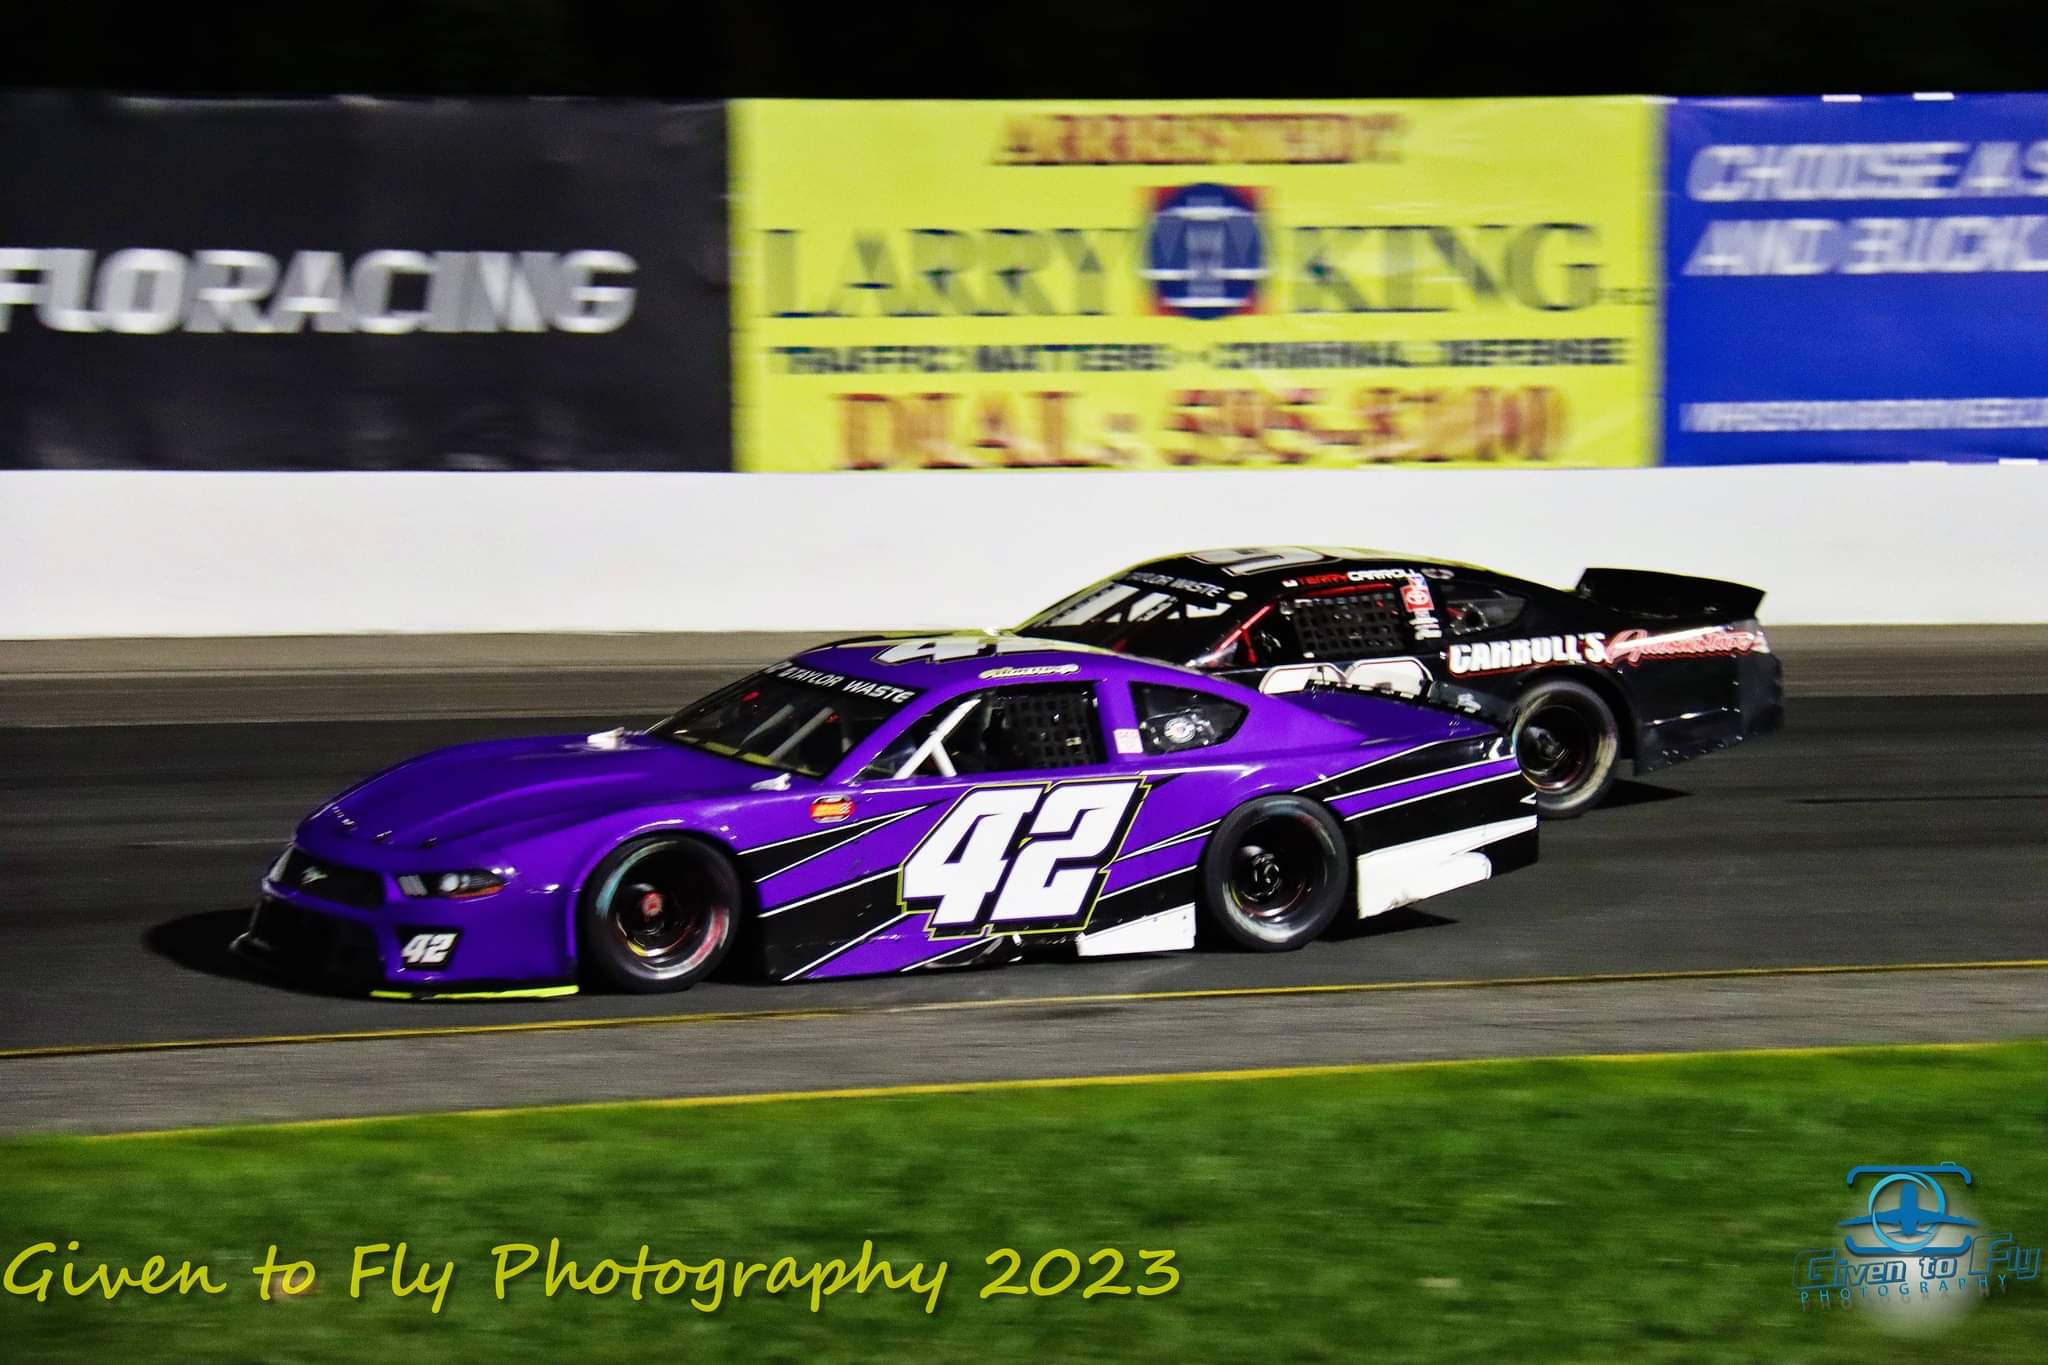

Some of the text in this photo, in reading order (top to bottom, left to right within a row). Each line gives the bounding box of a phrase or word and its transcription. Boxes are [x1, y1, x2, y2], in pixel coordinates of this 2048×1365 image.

[1686, 142, 1970, 201] CHOOSE
[0, 248, 637, 334] FLORACING
[761, 221, 1603, 317] LARRY KING
[770, 345, 955, 374] TRAFFIC
[964, 343, 1170, 372] MATTERS
[1435, 337, 1630, 367] DEFENSE
[1450, 631, 1608, 675] CARROLL'S
[786, 668, 845, 688] TAYLOR
[842, 680, 916, 703] WASTE
[902, 781, 1140, 926] 42
[401, 933, 458, 963] 42
